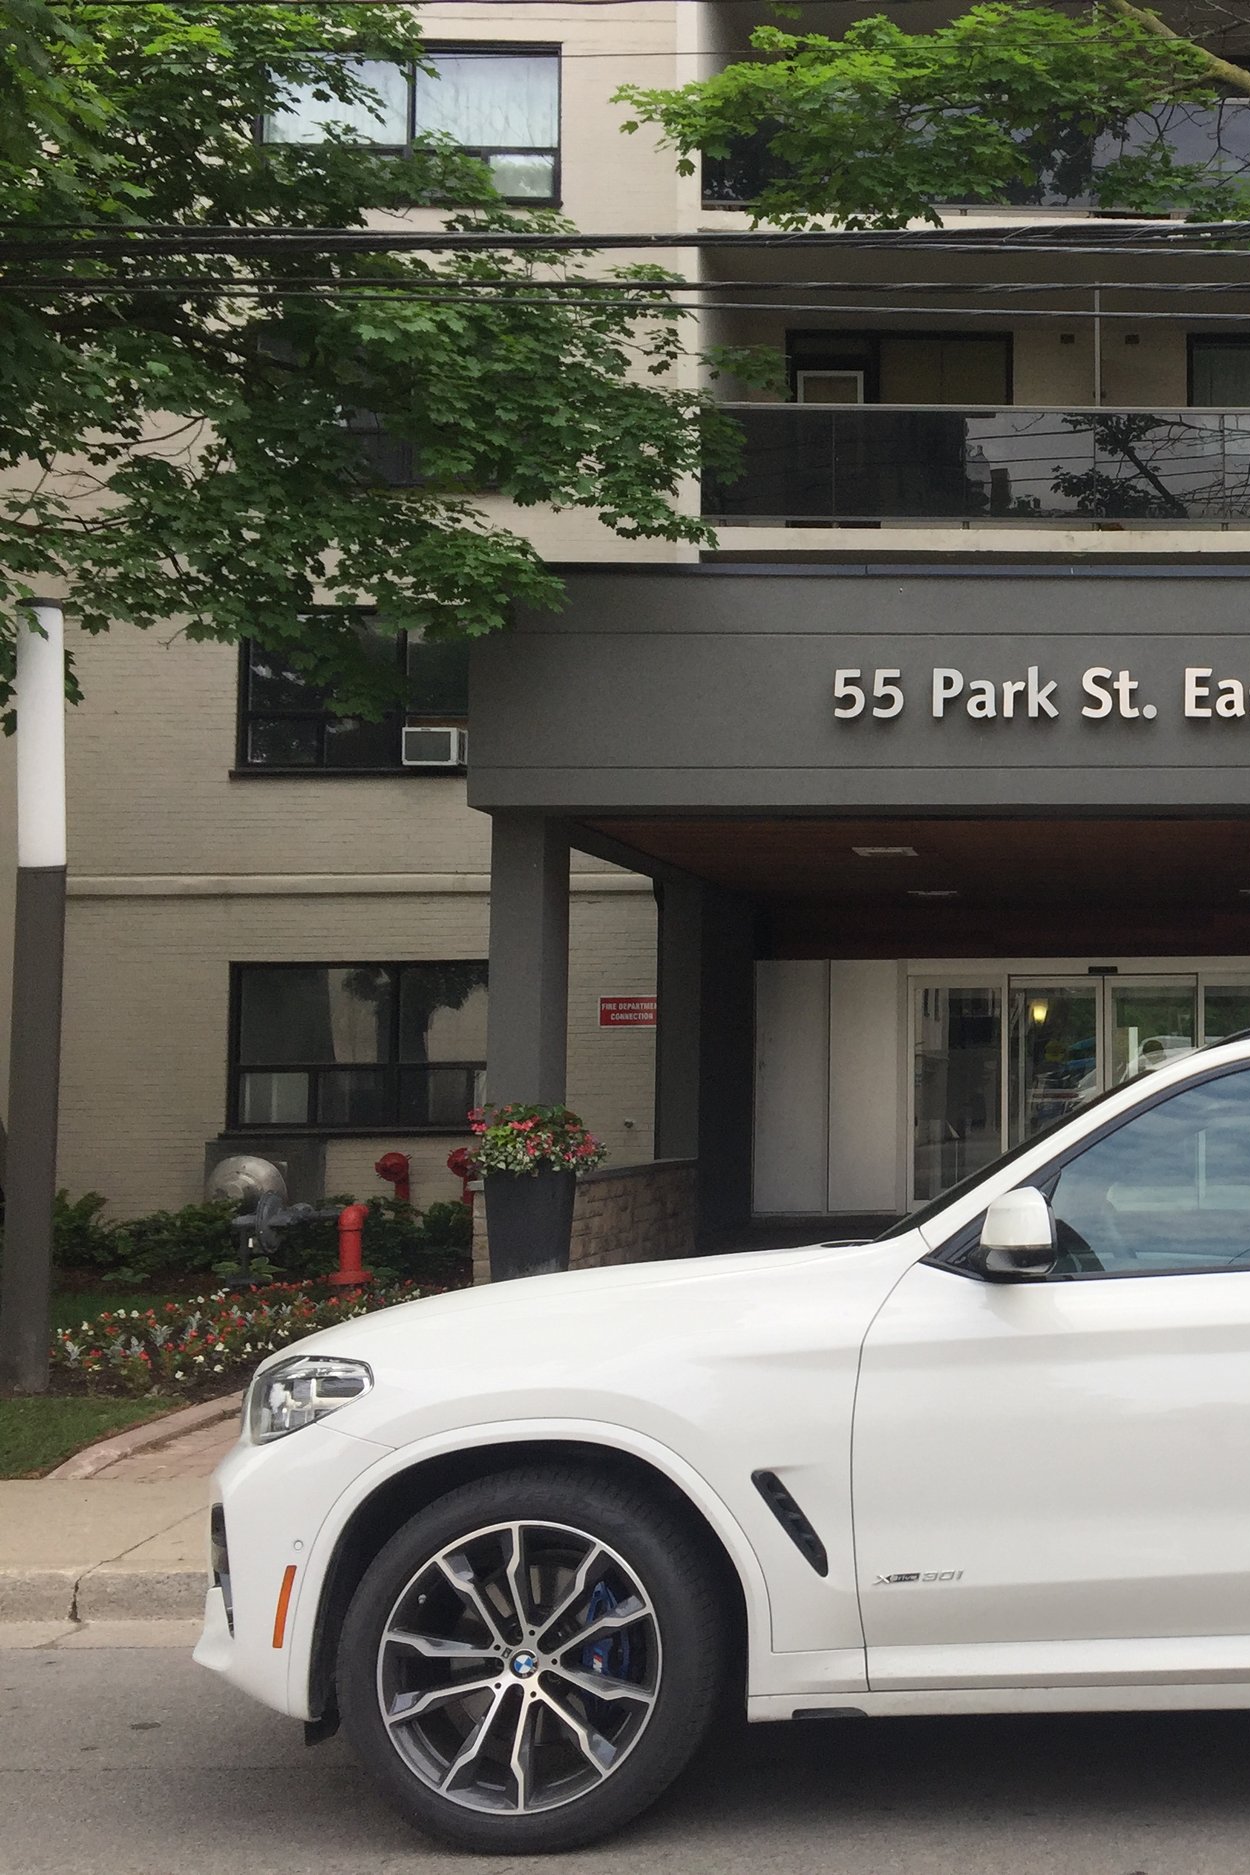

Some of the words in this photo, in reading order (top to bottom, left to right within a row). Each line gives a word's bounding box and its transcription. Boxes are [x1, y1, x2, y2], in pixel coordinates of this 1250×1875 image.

[834, 668, 904, 719] 55
[932, 665, 1059, 719] Park
[1081, 666, 1157, 719] St.
[610, 1013, 654, 1021] CONNECTION
